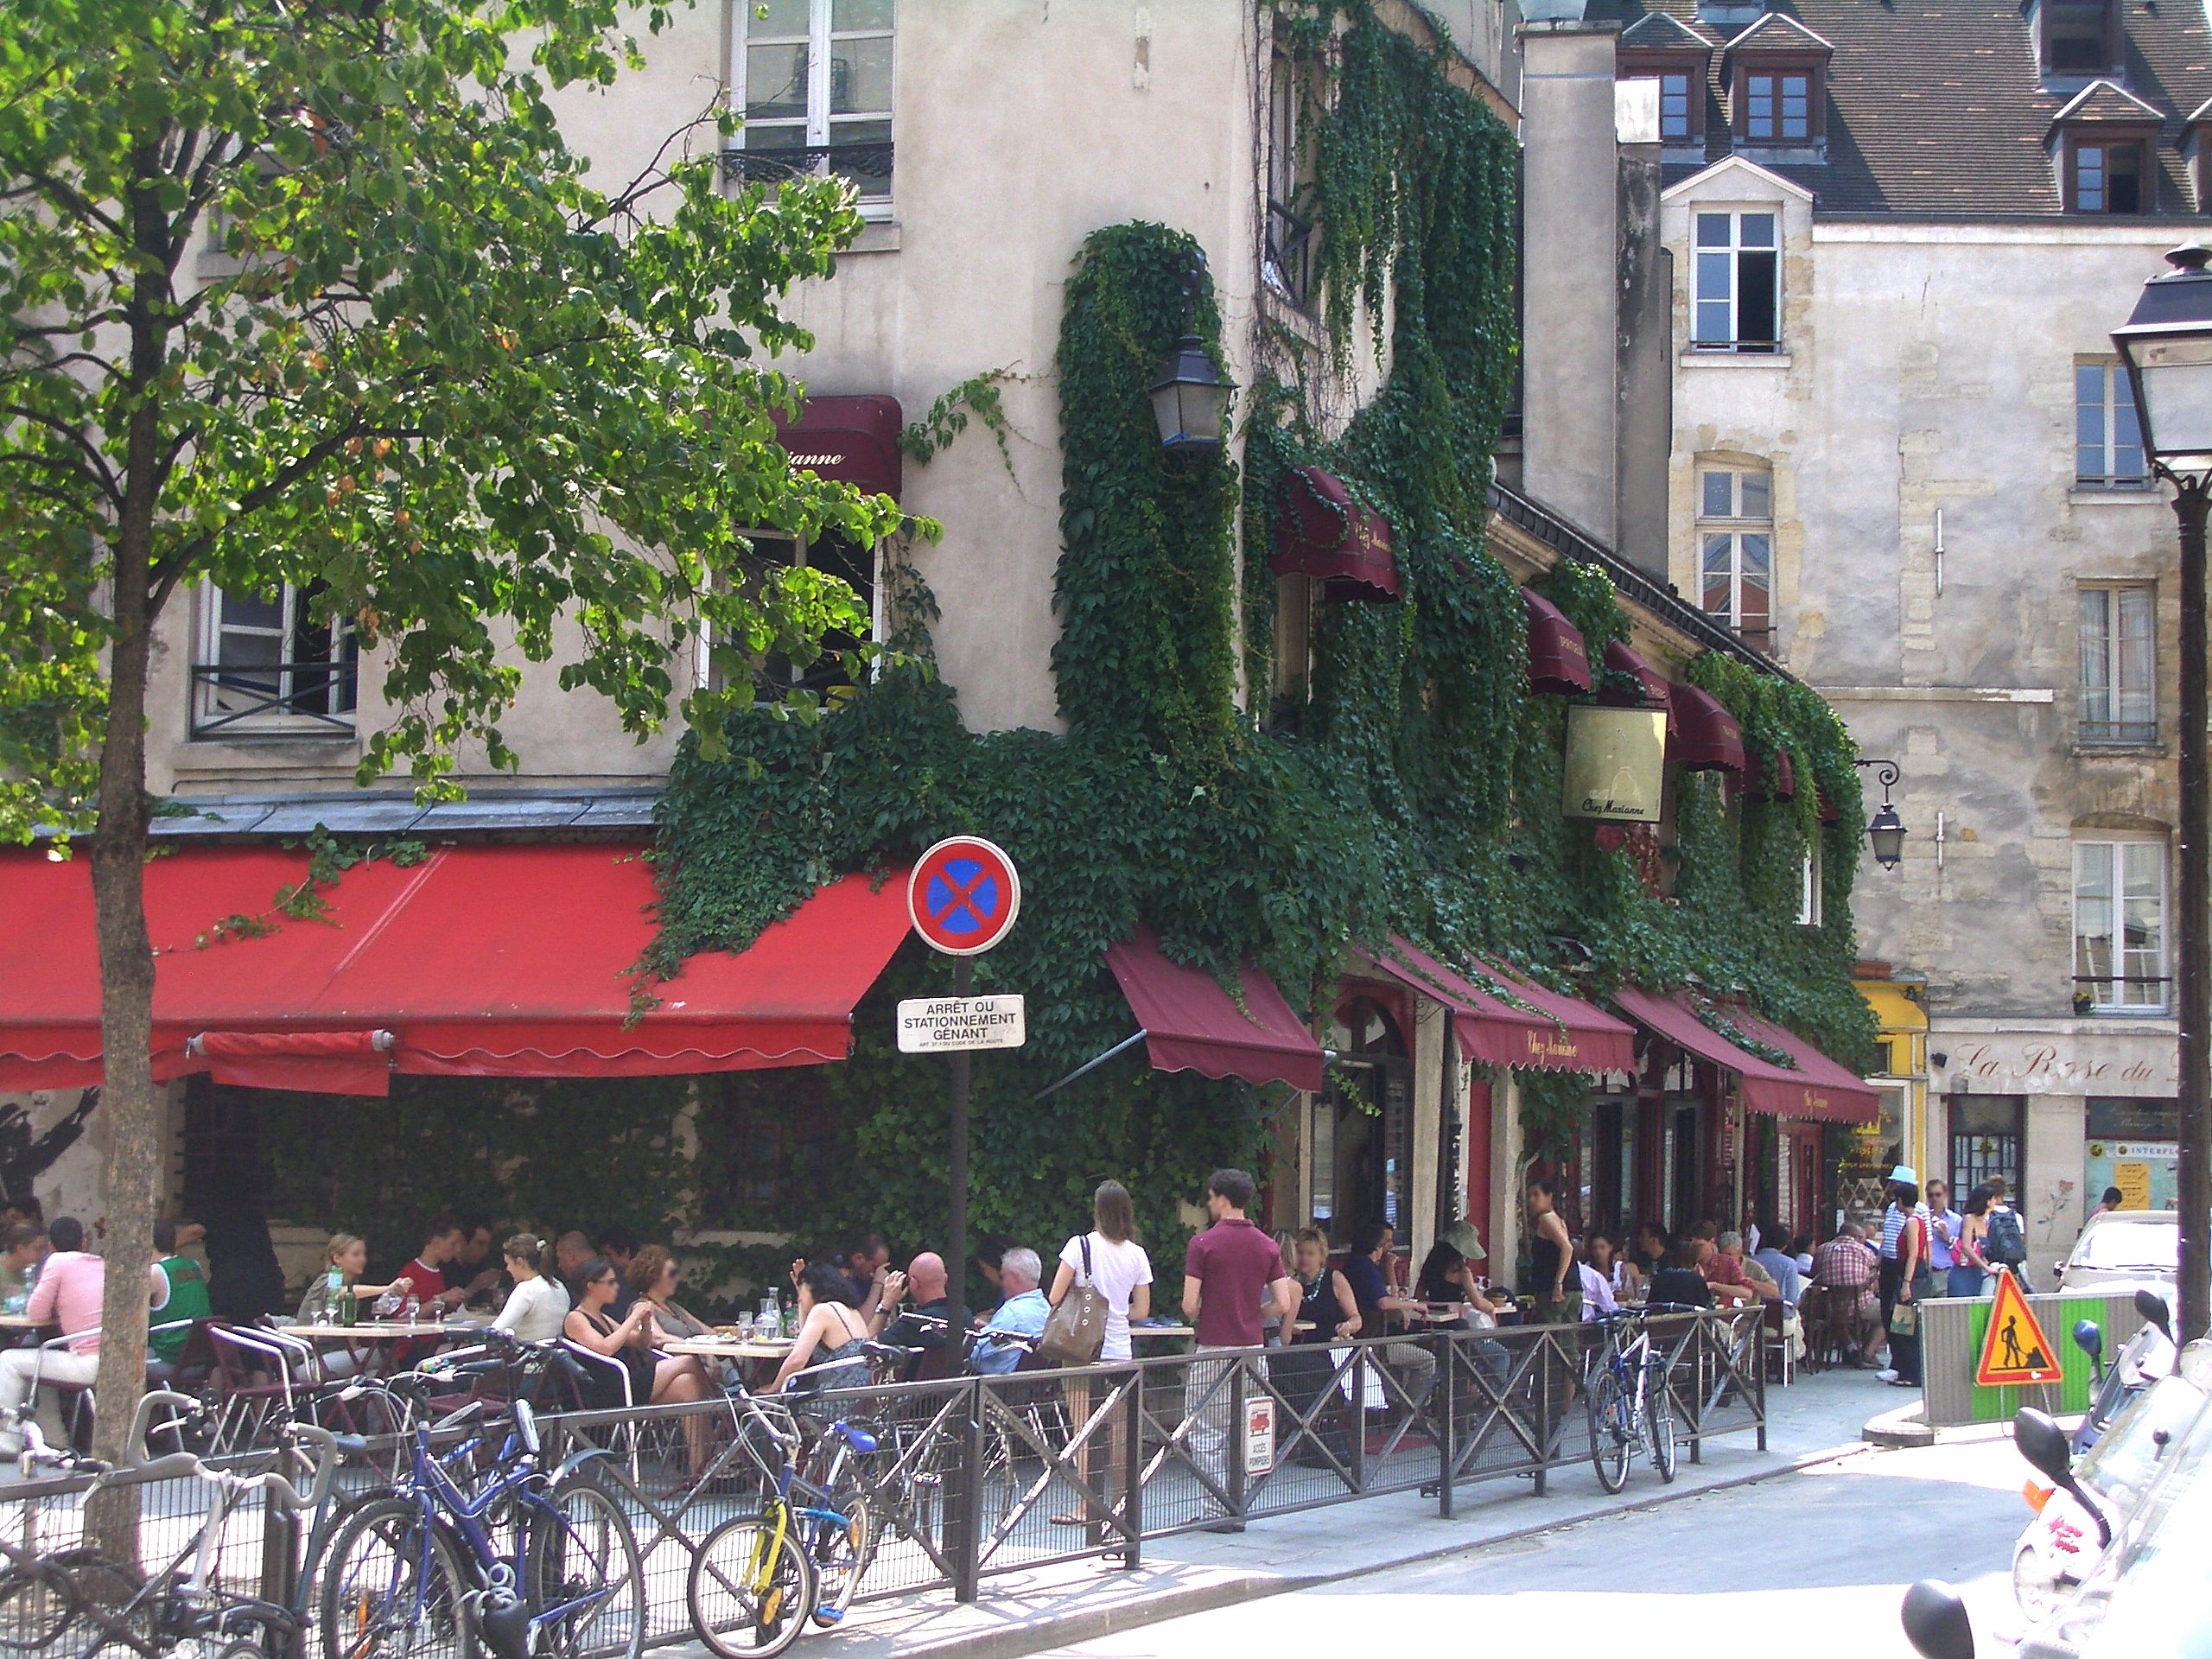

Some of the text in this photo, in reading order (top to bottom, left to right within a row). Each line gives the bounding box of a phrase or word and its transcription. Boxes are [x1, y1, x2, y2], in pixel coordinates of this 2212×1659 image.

[787, 451, 847, 466] ianne
[1603, 799, 1645, 815] Marianne
[926, 1001, 995, 1014] ARRÊT OU
[904, 1014, 1017, 1028] STATIONNEMENT
[1955, 1043, 2002, 1078] La
[2012, 1041, 2113, 1078] Rose
[2121, 1060, 2154, 1080] du
